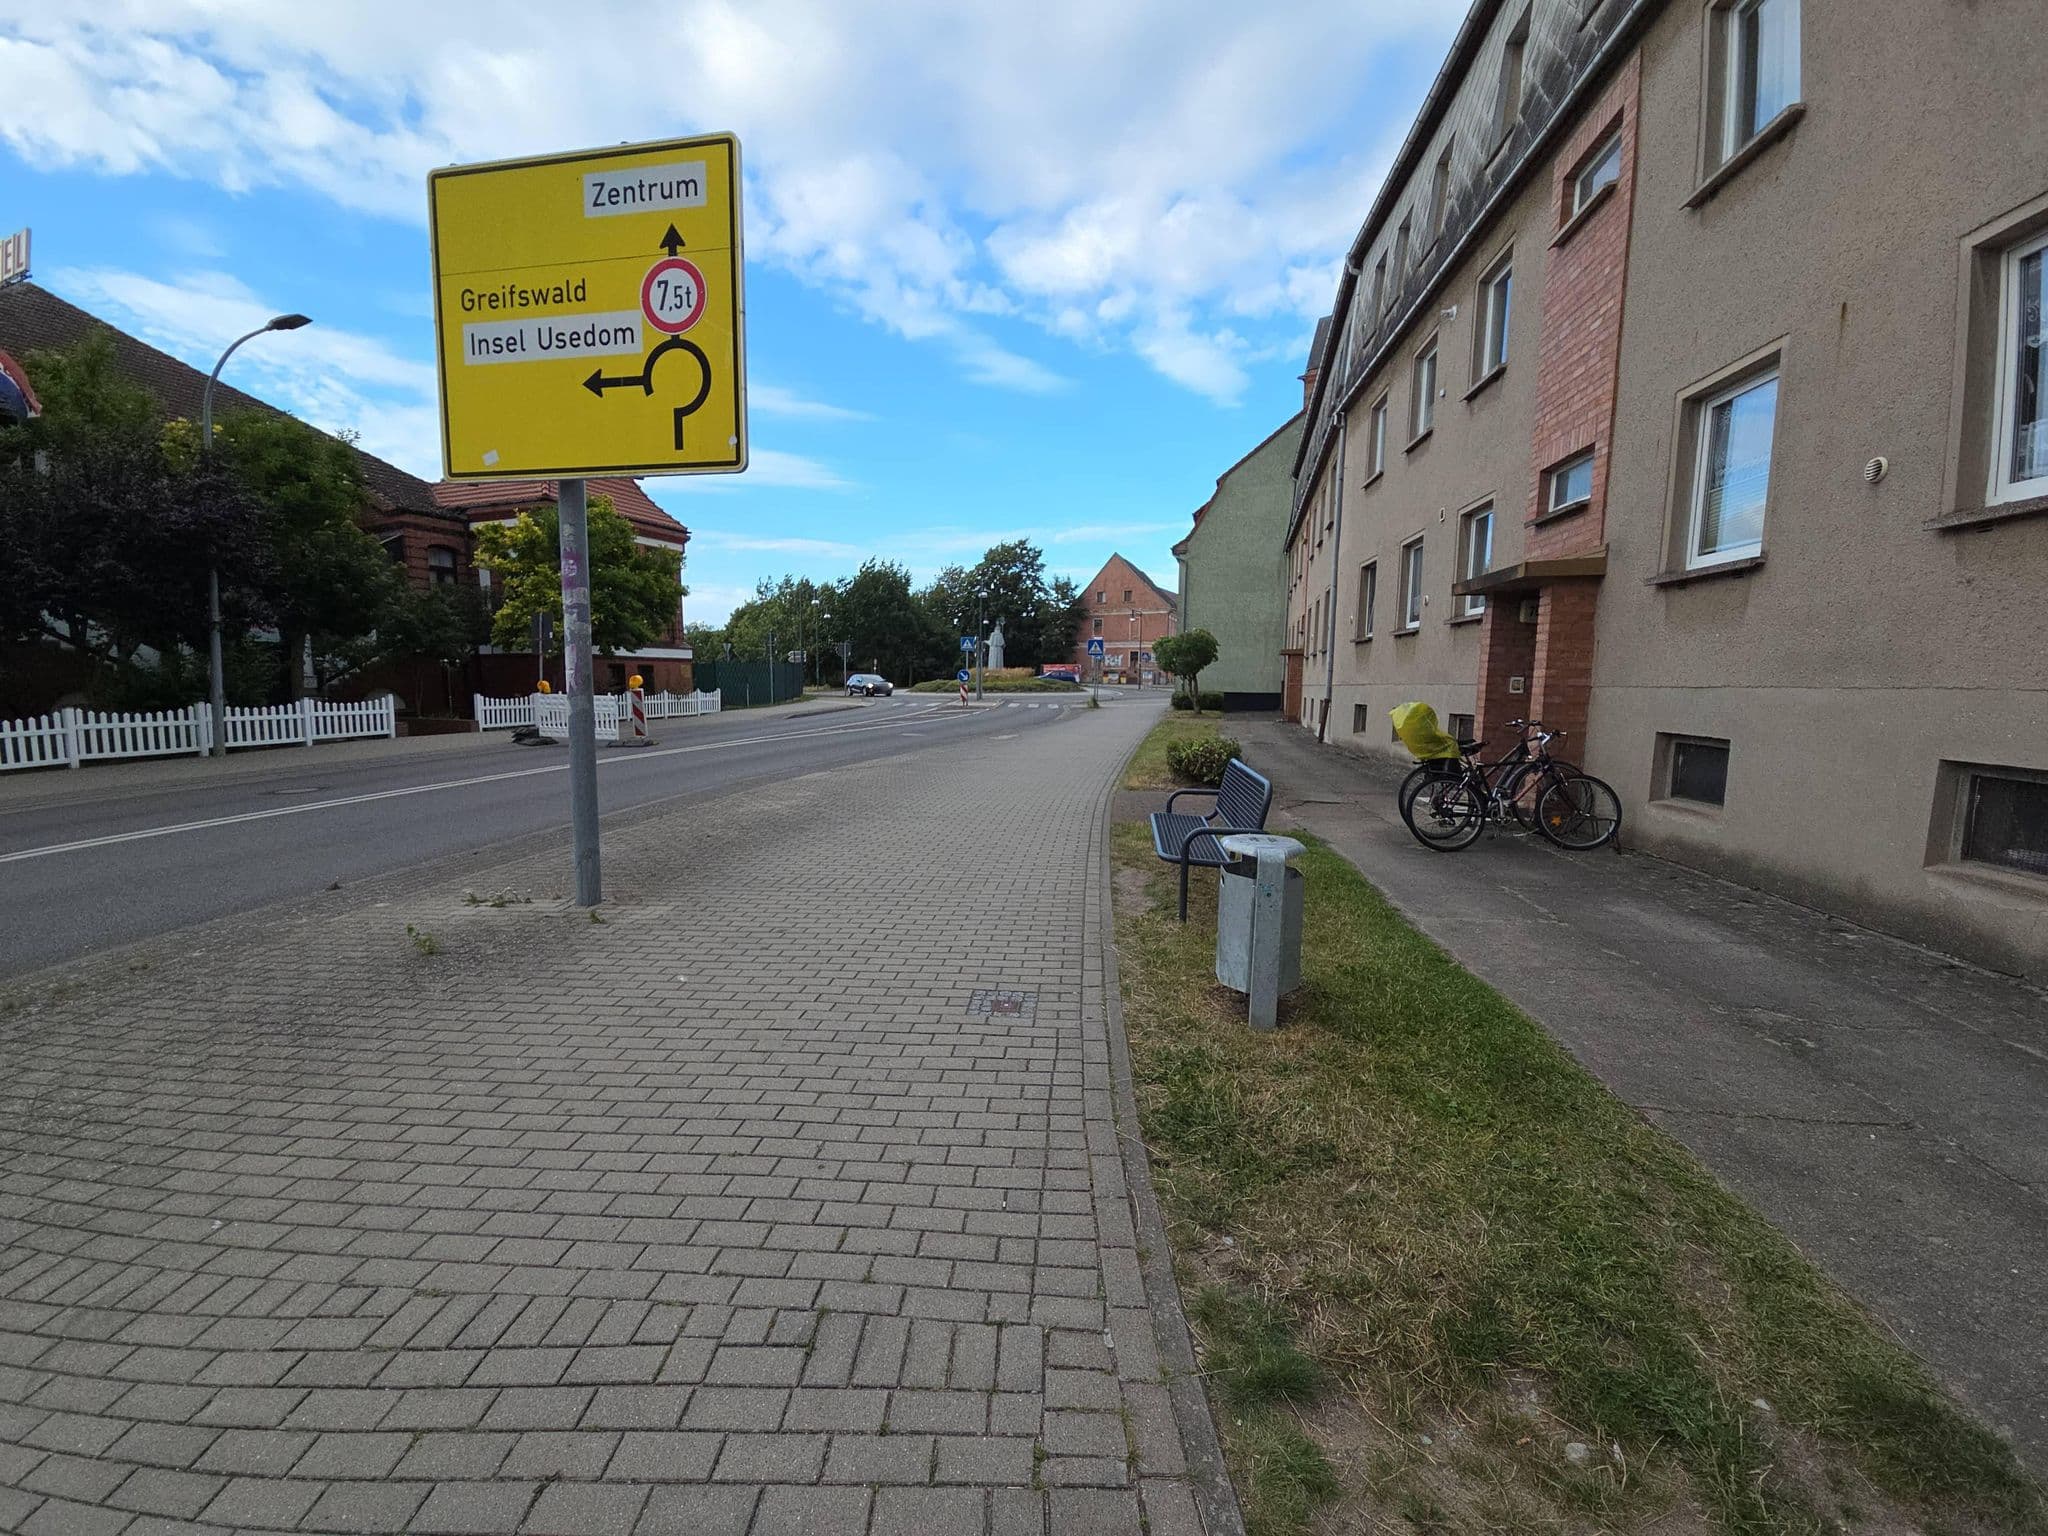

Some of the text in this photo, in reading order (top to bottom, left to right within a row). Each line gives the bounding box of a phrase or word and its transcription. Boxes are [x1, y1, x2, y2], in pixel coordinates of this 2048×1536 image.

[592, 176, 699, 208] Zentrum
[0, 234, 24, 274] EL
[460, 278, 587, 312] Greifswald
[656, 279, 693, 312] 7,5t
[470, 323, 635, 356] Insel Usedom
